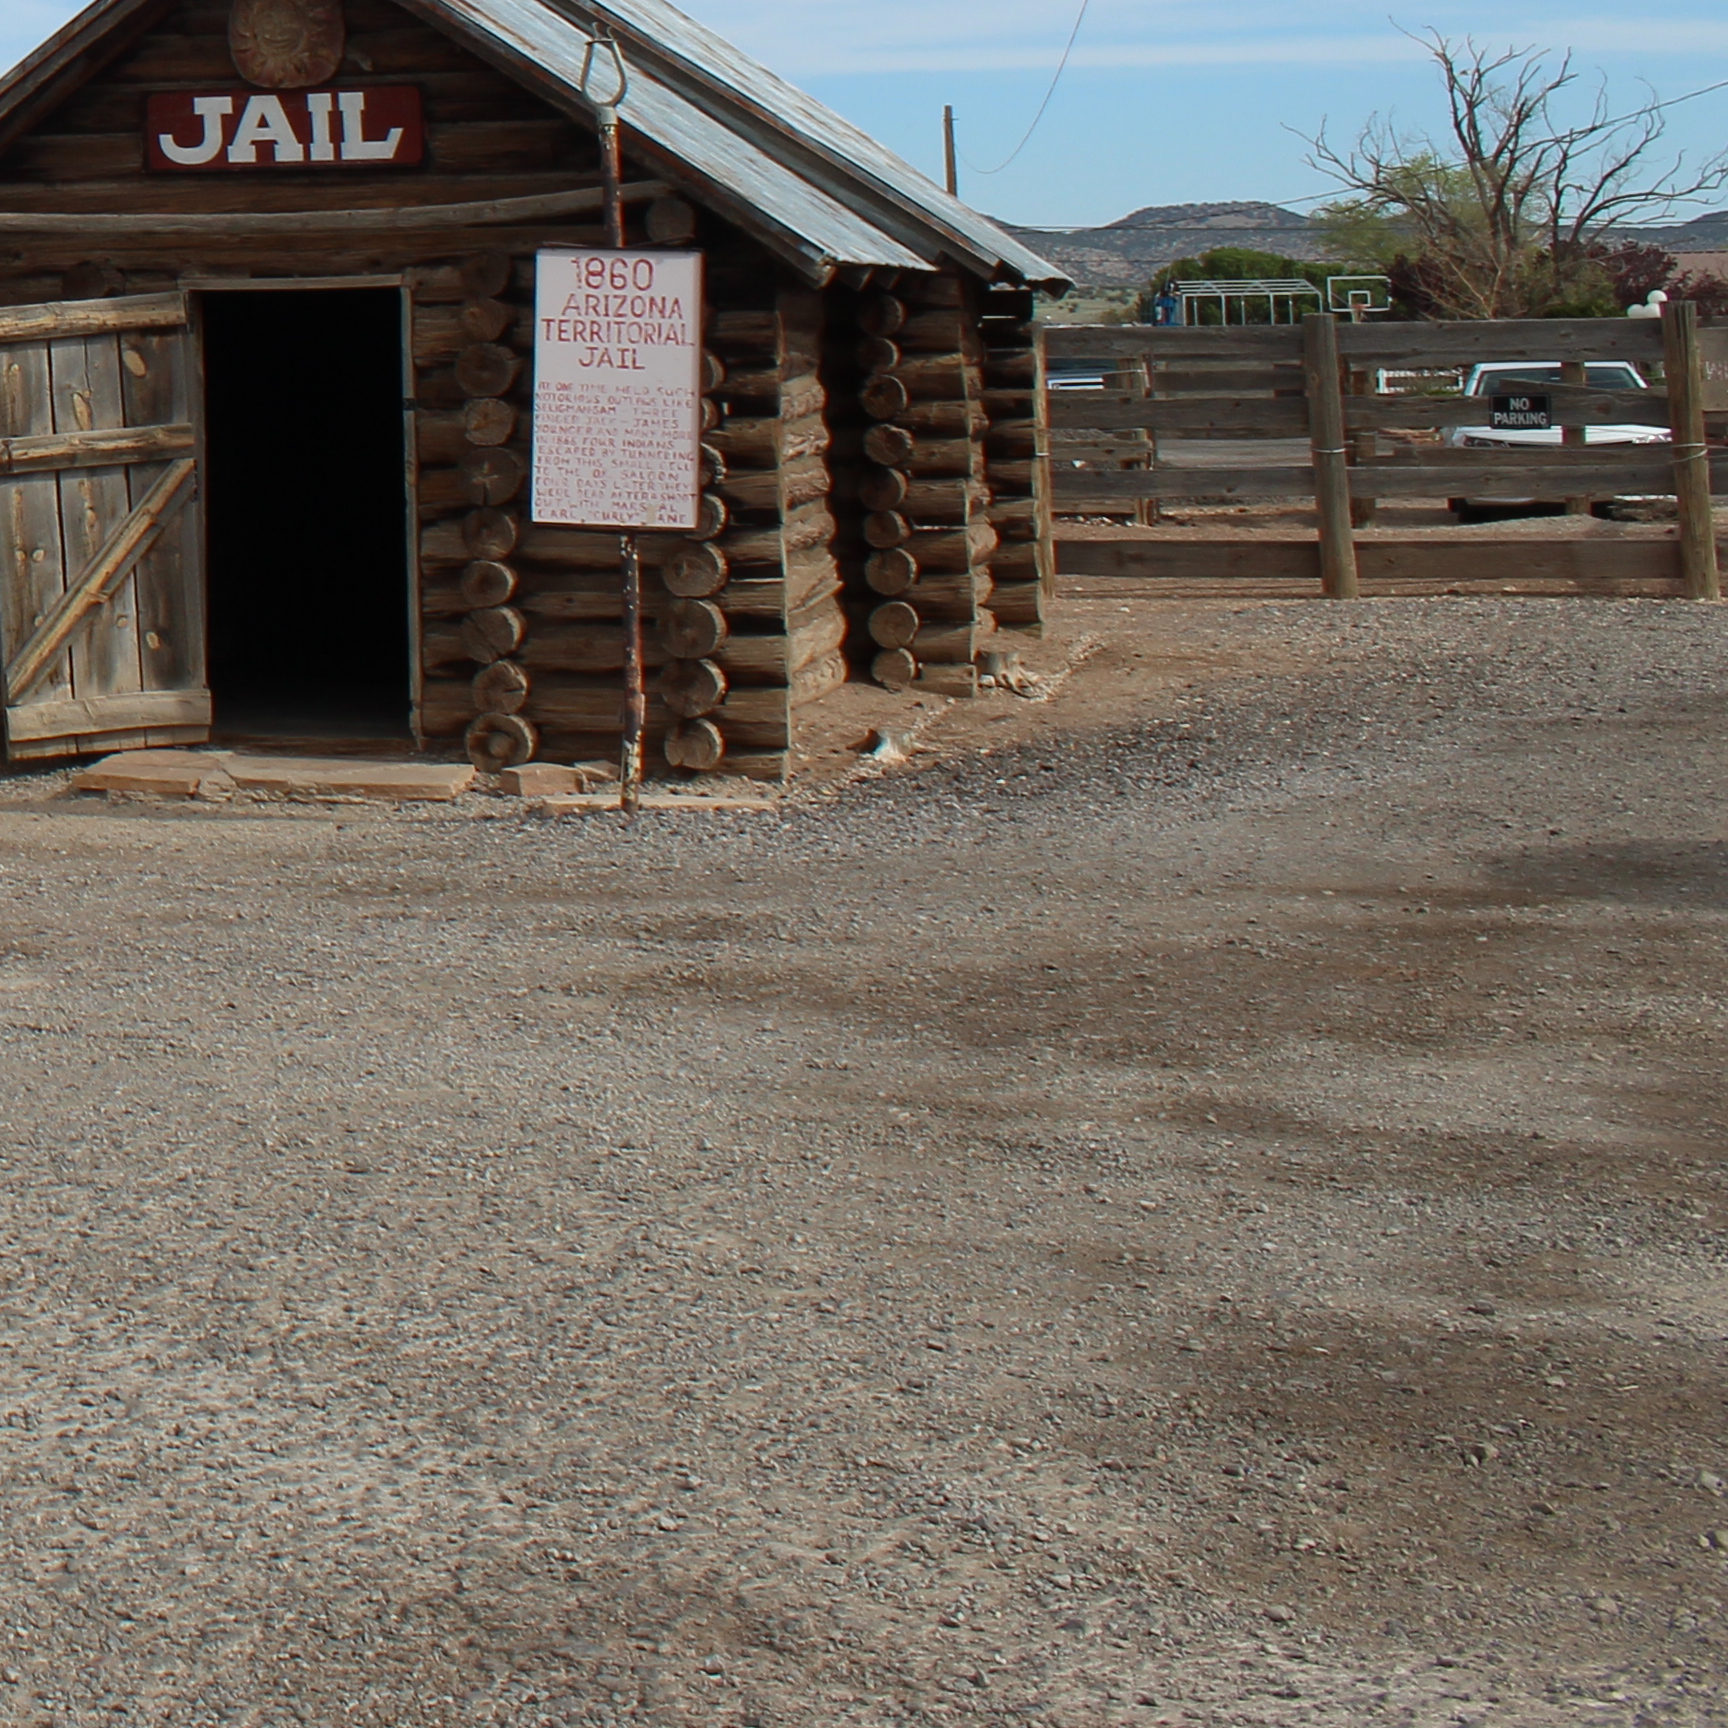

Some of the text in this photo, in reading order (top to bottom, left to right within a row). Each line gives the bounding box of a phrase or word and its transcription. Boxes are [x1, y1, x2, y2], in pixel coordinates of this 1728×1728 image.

[158, 91, 404, 166] JAIL
[571, 257, 654, 291] 1860
[561, 293, 683, 320] ARIZONA
[541, 318, 695, 346] TERRITORIAL
[578, 346, 646, 370] JAIL
[1508, 396, 1530, 411] NO
[632, 416, 679, 430] JAMES
[1493, 411, 1547, 426] PARKING
[537, 444, 596, 457] ESCAPED
[582, 436, 616, 448] FOUR
[621, 437, 675, 450] INDIANS
[536, 455, 570, 466] FROM
[575, 457, 603, 468] THIS
[620, 469, 679, 482] SALOON
[611, 500, 677, 513] MARSAL
